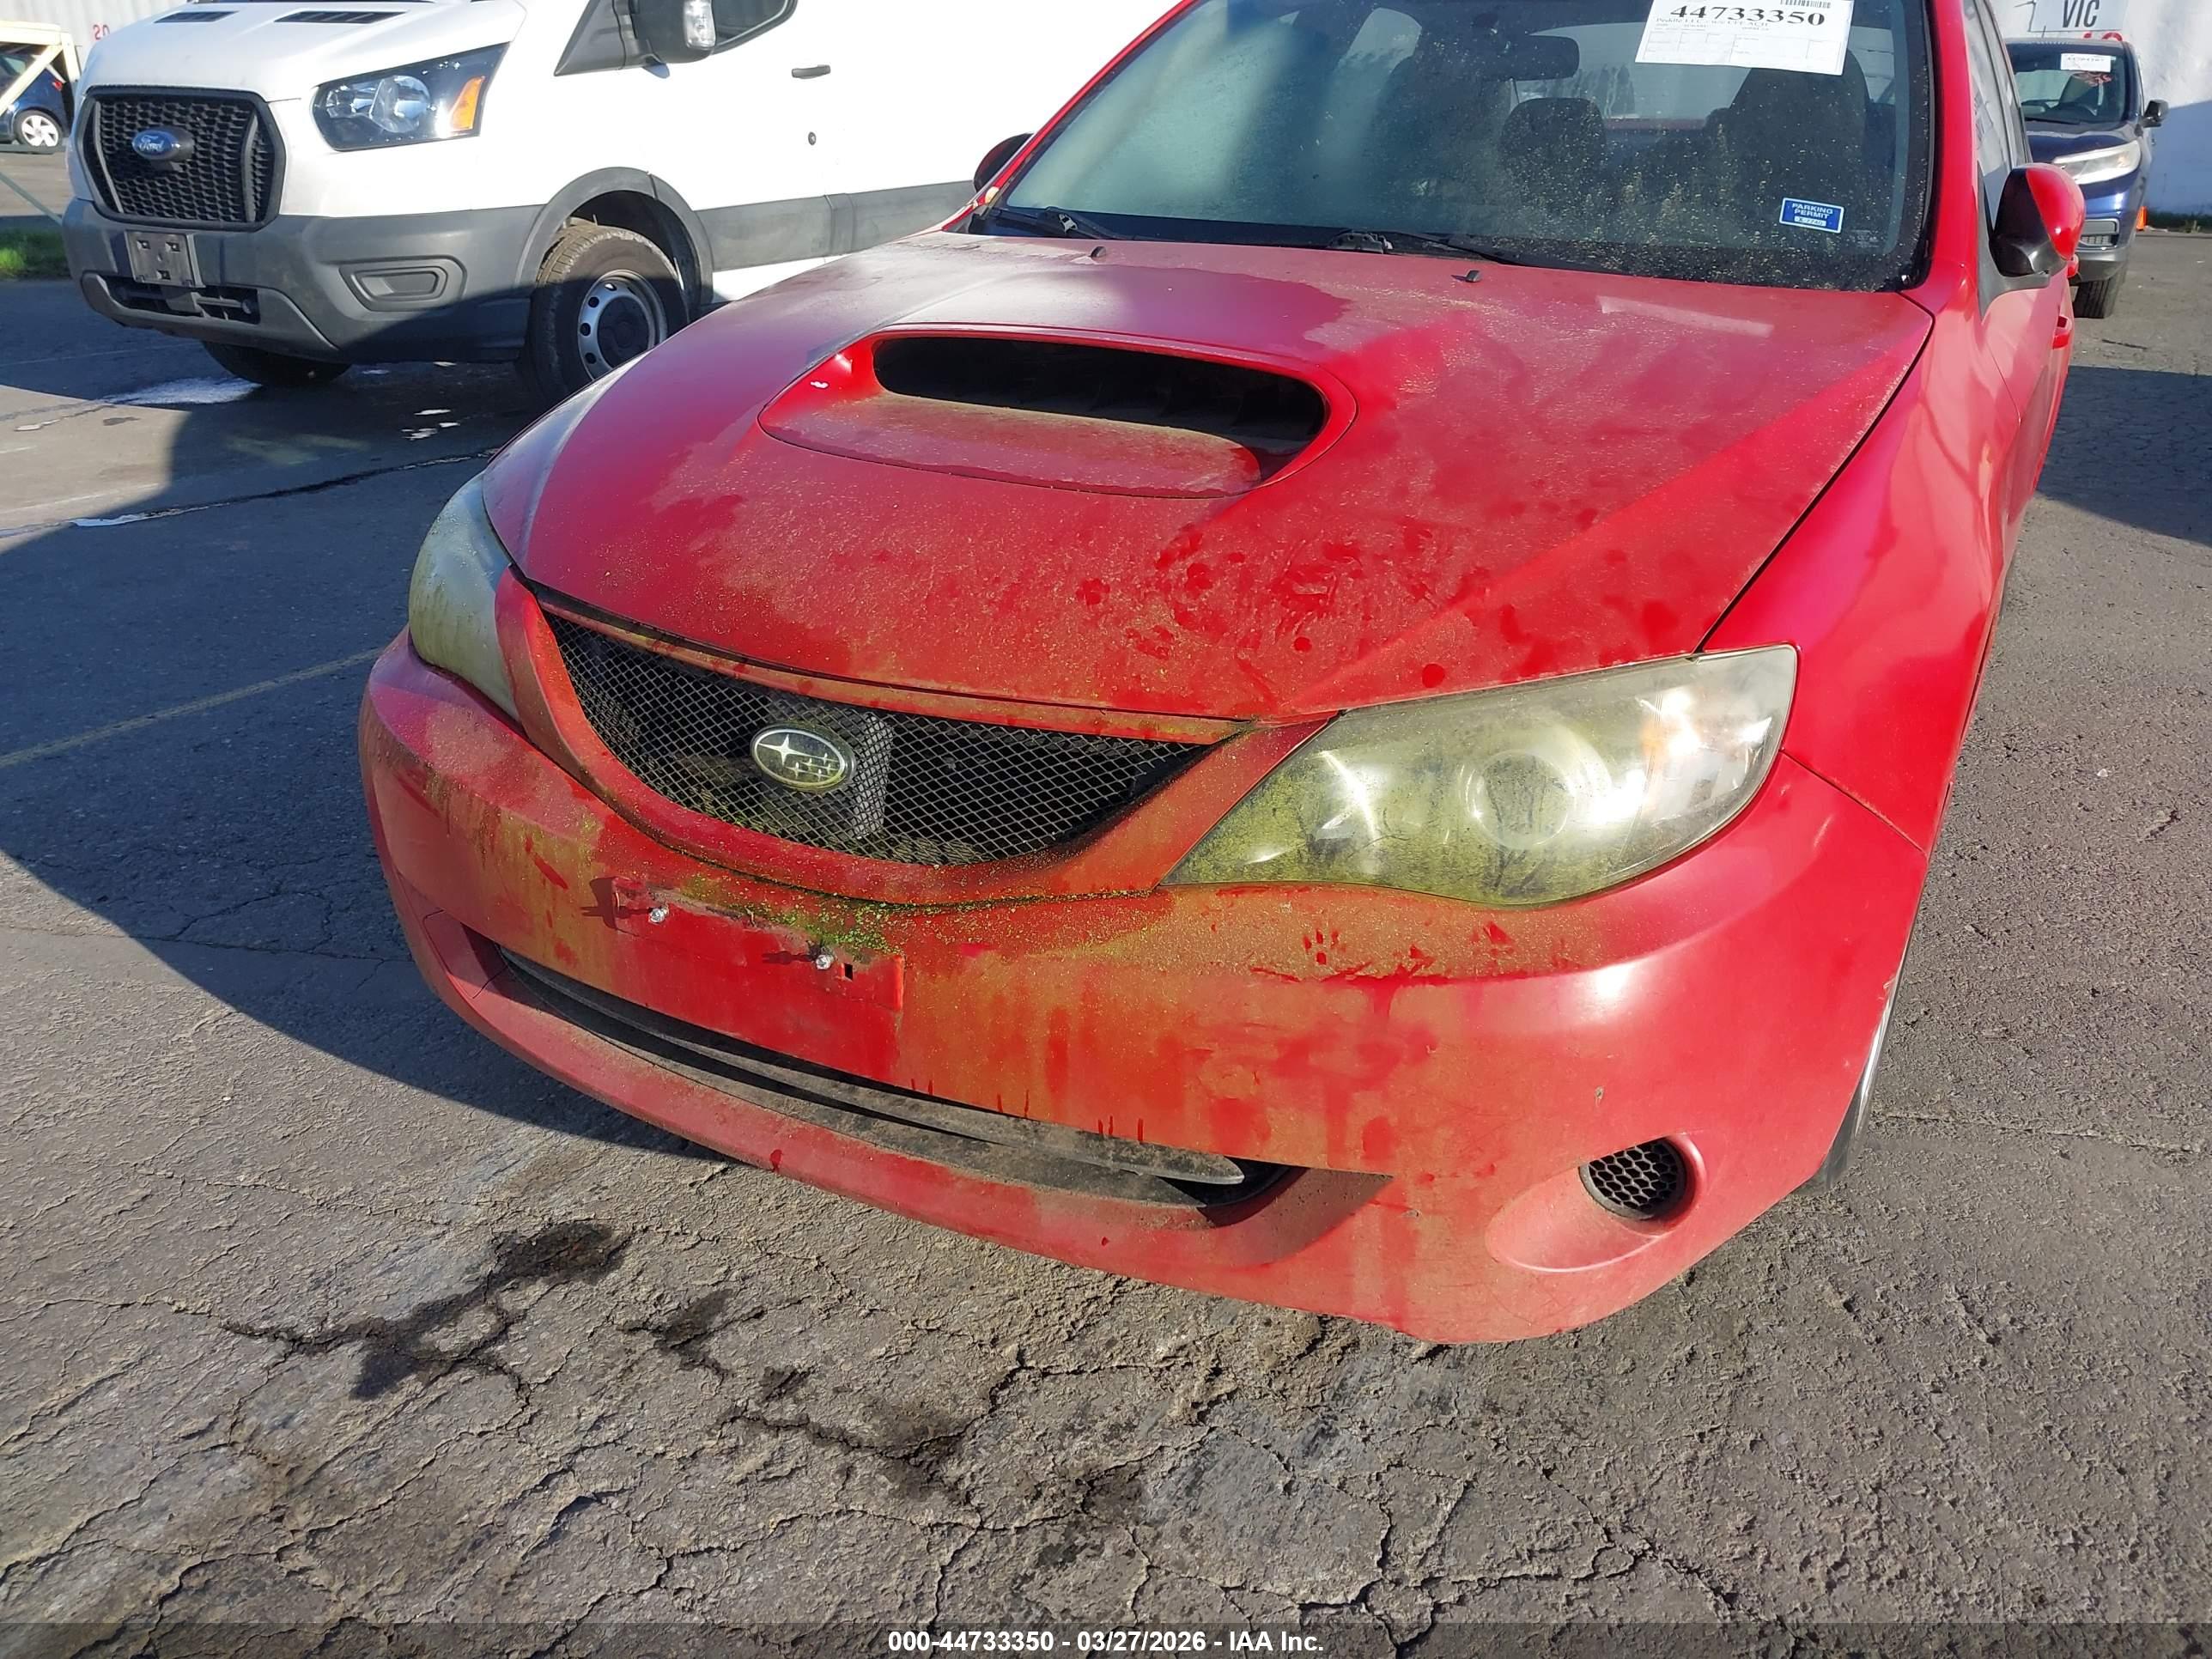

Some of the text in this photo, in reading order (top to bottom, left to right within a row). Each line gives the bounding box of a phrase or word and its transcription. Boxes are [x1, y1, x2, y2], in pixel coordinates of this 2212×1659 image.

[1670, 5, 1825, 26] 44733350
[2063, 0, 2100, 27] VIC
[139, 134, 164, 151] Ford
[1791, 203, 1833, 215] PARKING
[1794, 209, 1830, 219] PERMIT
